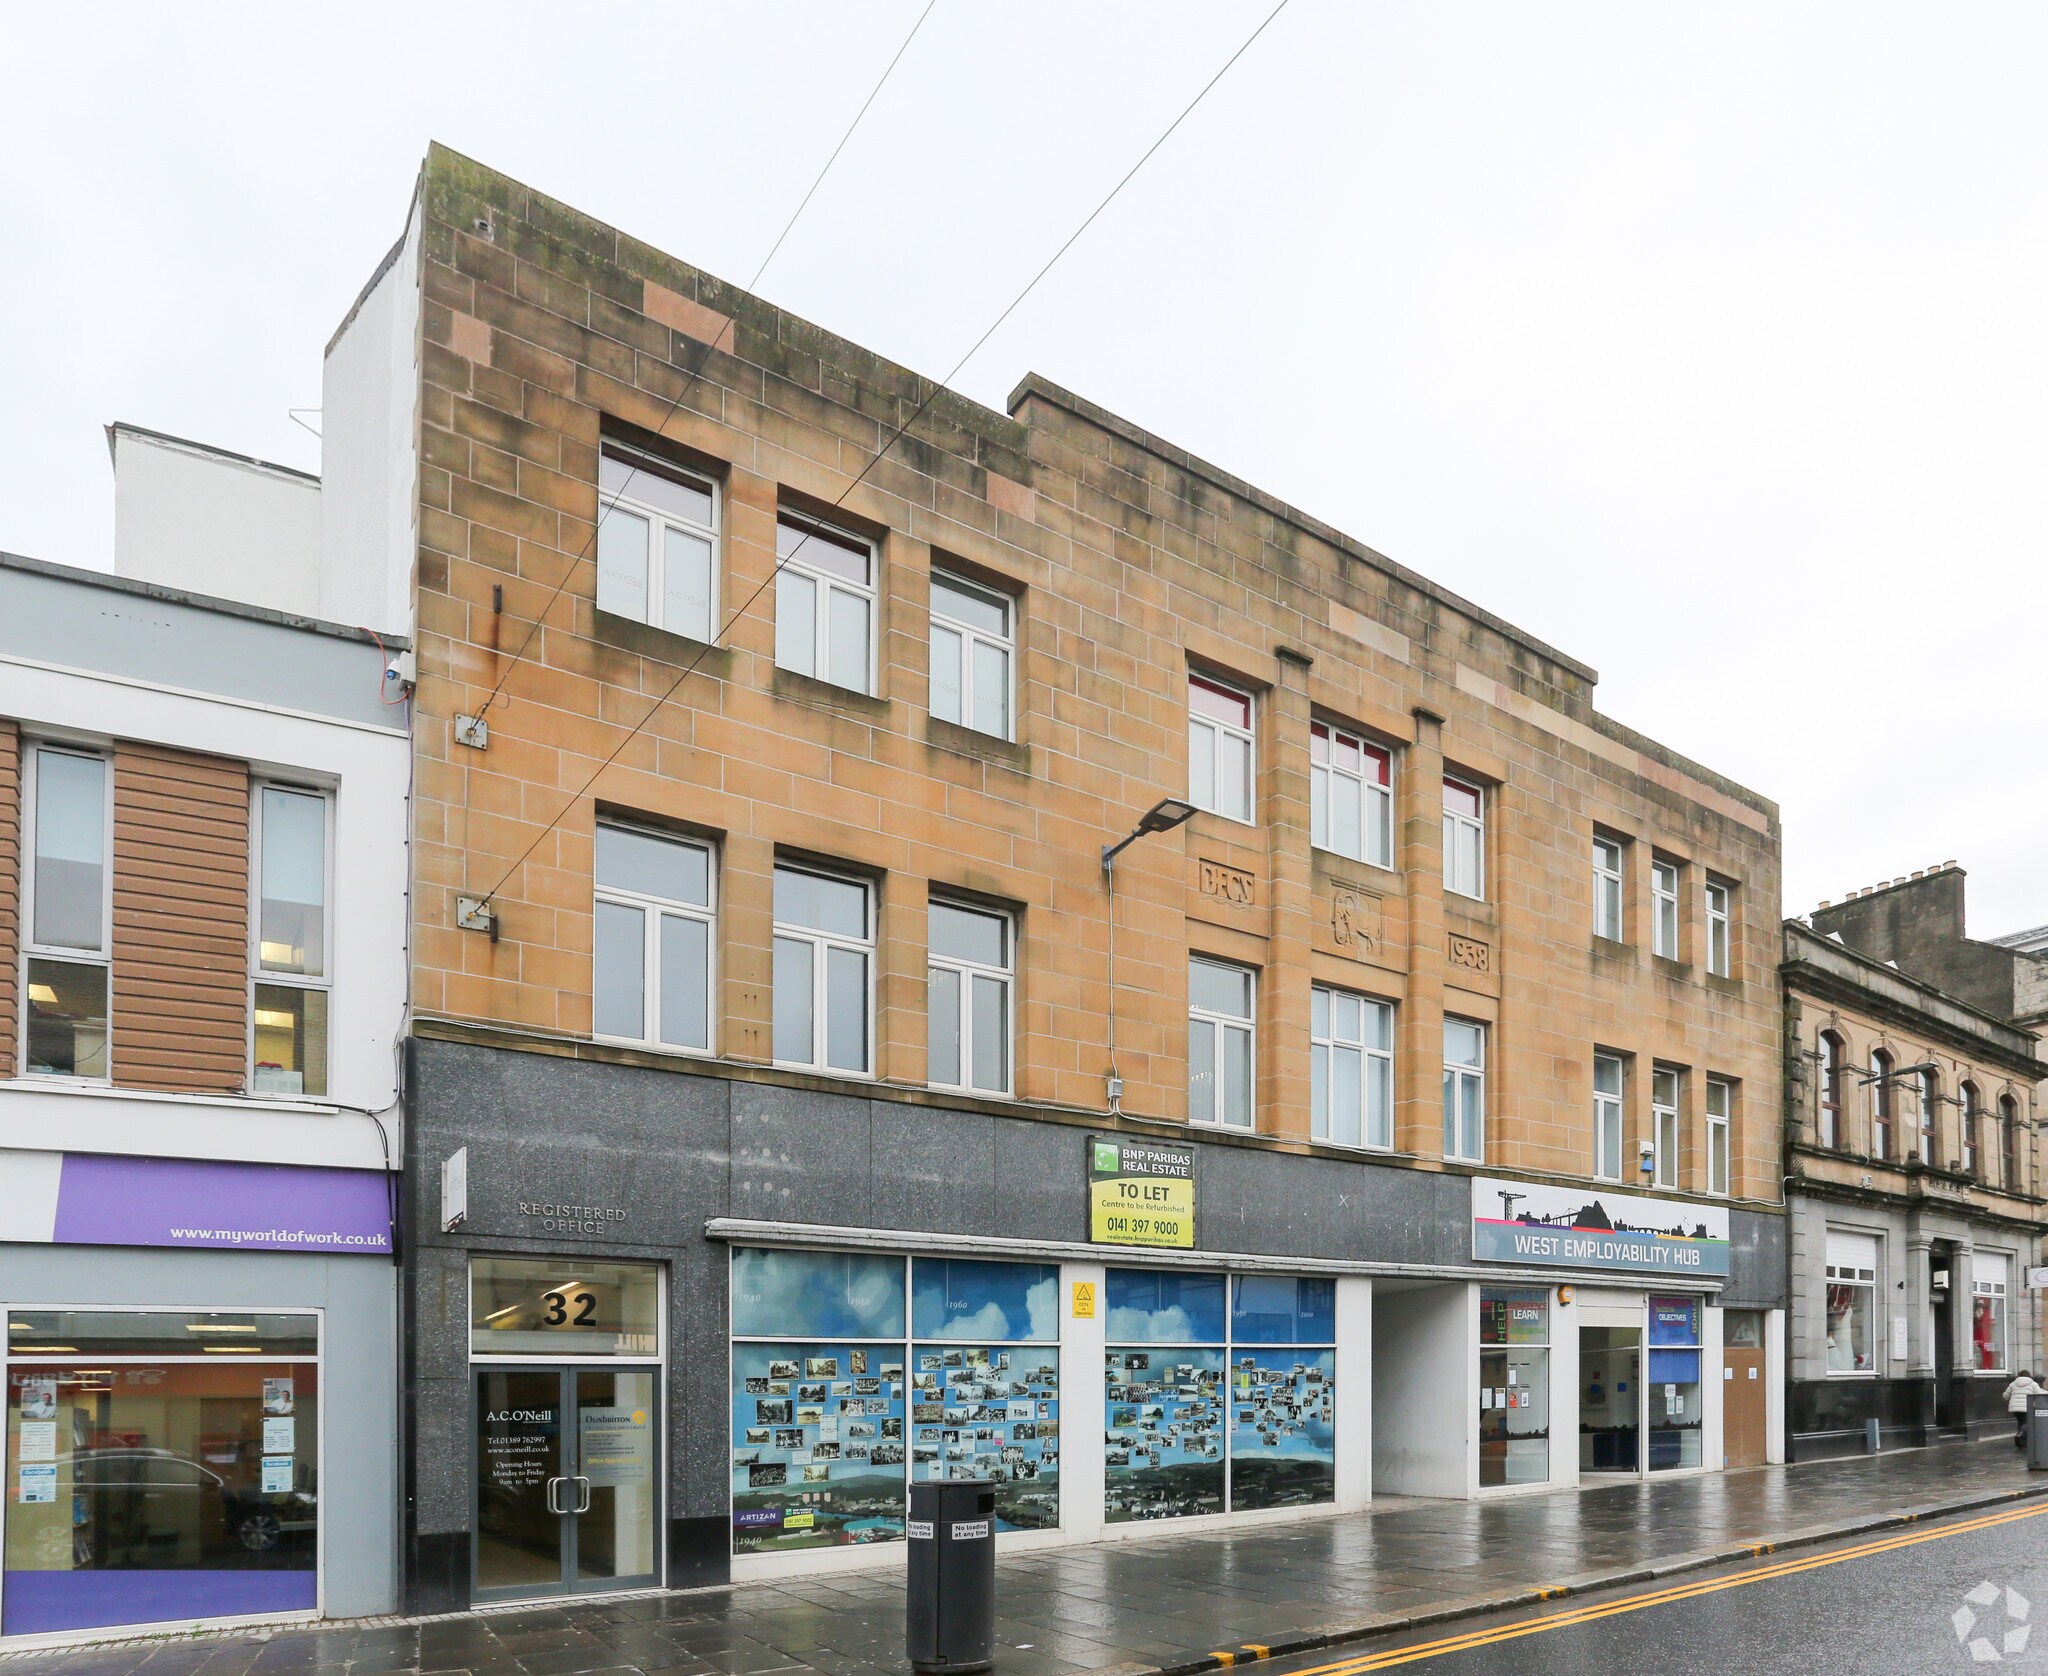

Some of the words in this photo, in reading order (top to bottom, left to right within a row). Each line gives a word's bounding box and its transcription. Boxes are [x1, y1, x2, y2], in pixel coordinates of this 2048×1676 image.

[1122, 1148, 1145, 1160] BNP
[1147, 1151, 1191, 1166] PARIBAS
[1123, 1161, 1150, 1173] REAL
[1151, 1164, 1188, 1177] ESTATE
[1118, 1183, 1139, 1199] TO
[1144, 1185, 1170, 1201] LET
[518, 1202, 626, 1221] REGISTERED
[1101, 1200, 1125, 1209] Centre
[1127, 1201, 1135, 1209] to
[1136, 1202, 1145, 1210] be
[1145, 1204, 1185, 1213] Refurbished
[543, 1219, 605, 1234] OFFICE
[1107, 1217, 1128, 1232] 0141
[1131, 1219, 1150, 1233] 397
[1154, 1221, 1179, 1235] 9000
[170, 1227, 387, 1246] www.myworldofwork.co.uk
[1514, 1234, 1560, 1256] WEST
[1564, 1239, 1670, 1264] EMPLOYABILITY
[1673, 1248, 1700, 1266] HUB
[739, 1294, 761, 1304] 1940
[851, 1298, 870, 1308] 1950
[949, 1299, 968, 1310] 1960
[543, 1292, 597, 1327] 32
[1232, 1310, 1247, 1319] 1990
[1513, 1309, 1539, 1320] LEARN
[1497, 1303, 1506, 1342] HELP
[1658, 1313, 1687, 1322] OBJECTIVES
[486, 1410, 552, 1421] A.C.O'Neill
[487, 1445, 550, 1454] www.aconeill.co.uk
[495, 1461, 523, 1469] Opening
[525, 1478, 539, 1486] 5pm
[739, 1513, 776, 1521] ARTIZAN
[1041, 1514, 1058, 1524] 1970
[966, 1523, 987, 1531] loading
[739, 1536, 762, 1547] 1940
